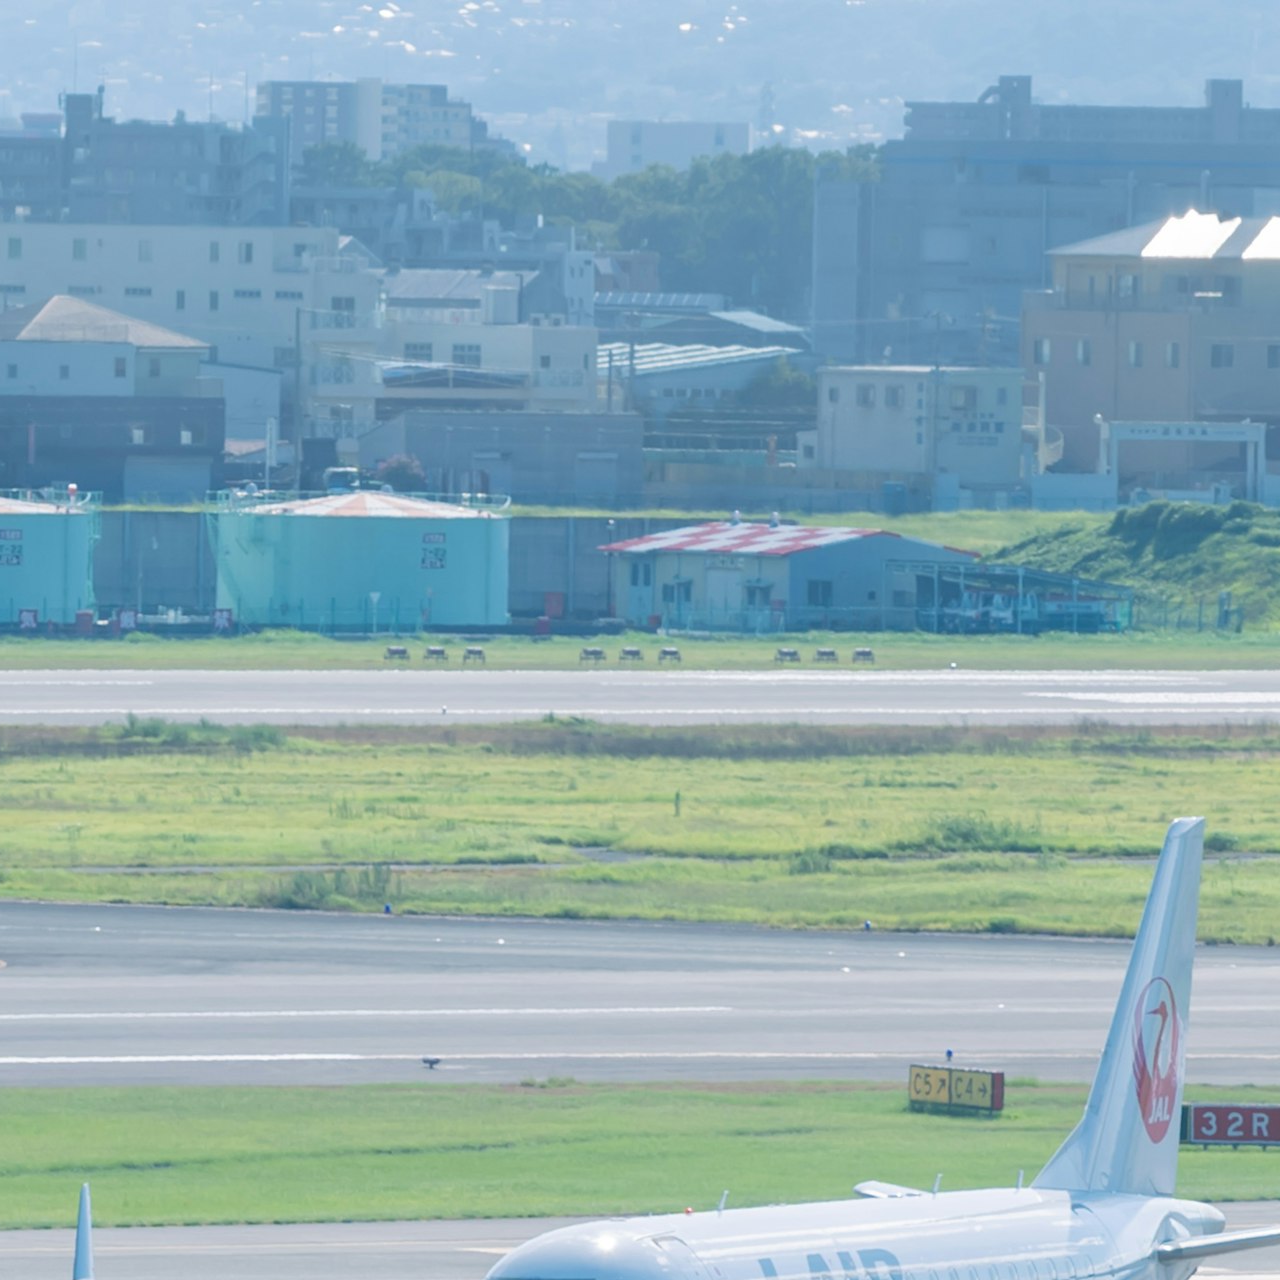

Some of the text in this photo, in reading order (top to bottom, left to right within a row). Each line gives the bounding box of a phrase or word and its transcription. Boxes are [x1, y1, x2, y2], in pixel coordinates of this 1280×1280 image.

[913, 1072, 932, 1096] C5
[955, 1077, 974, 1100] C4
[1148, 1095, 1170, 1124] JAL
[1200, 1111, 1269, 1138] 32R
